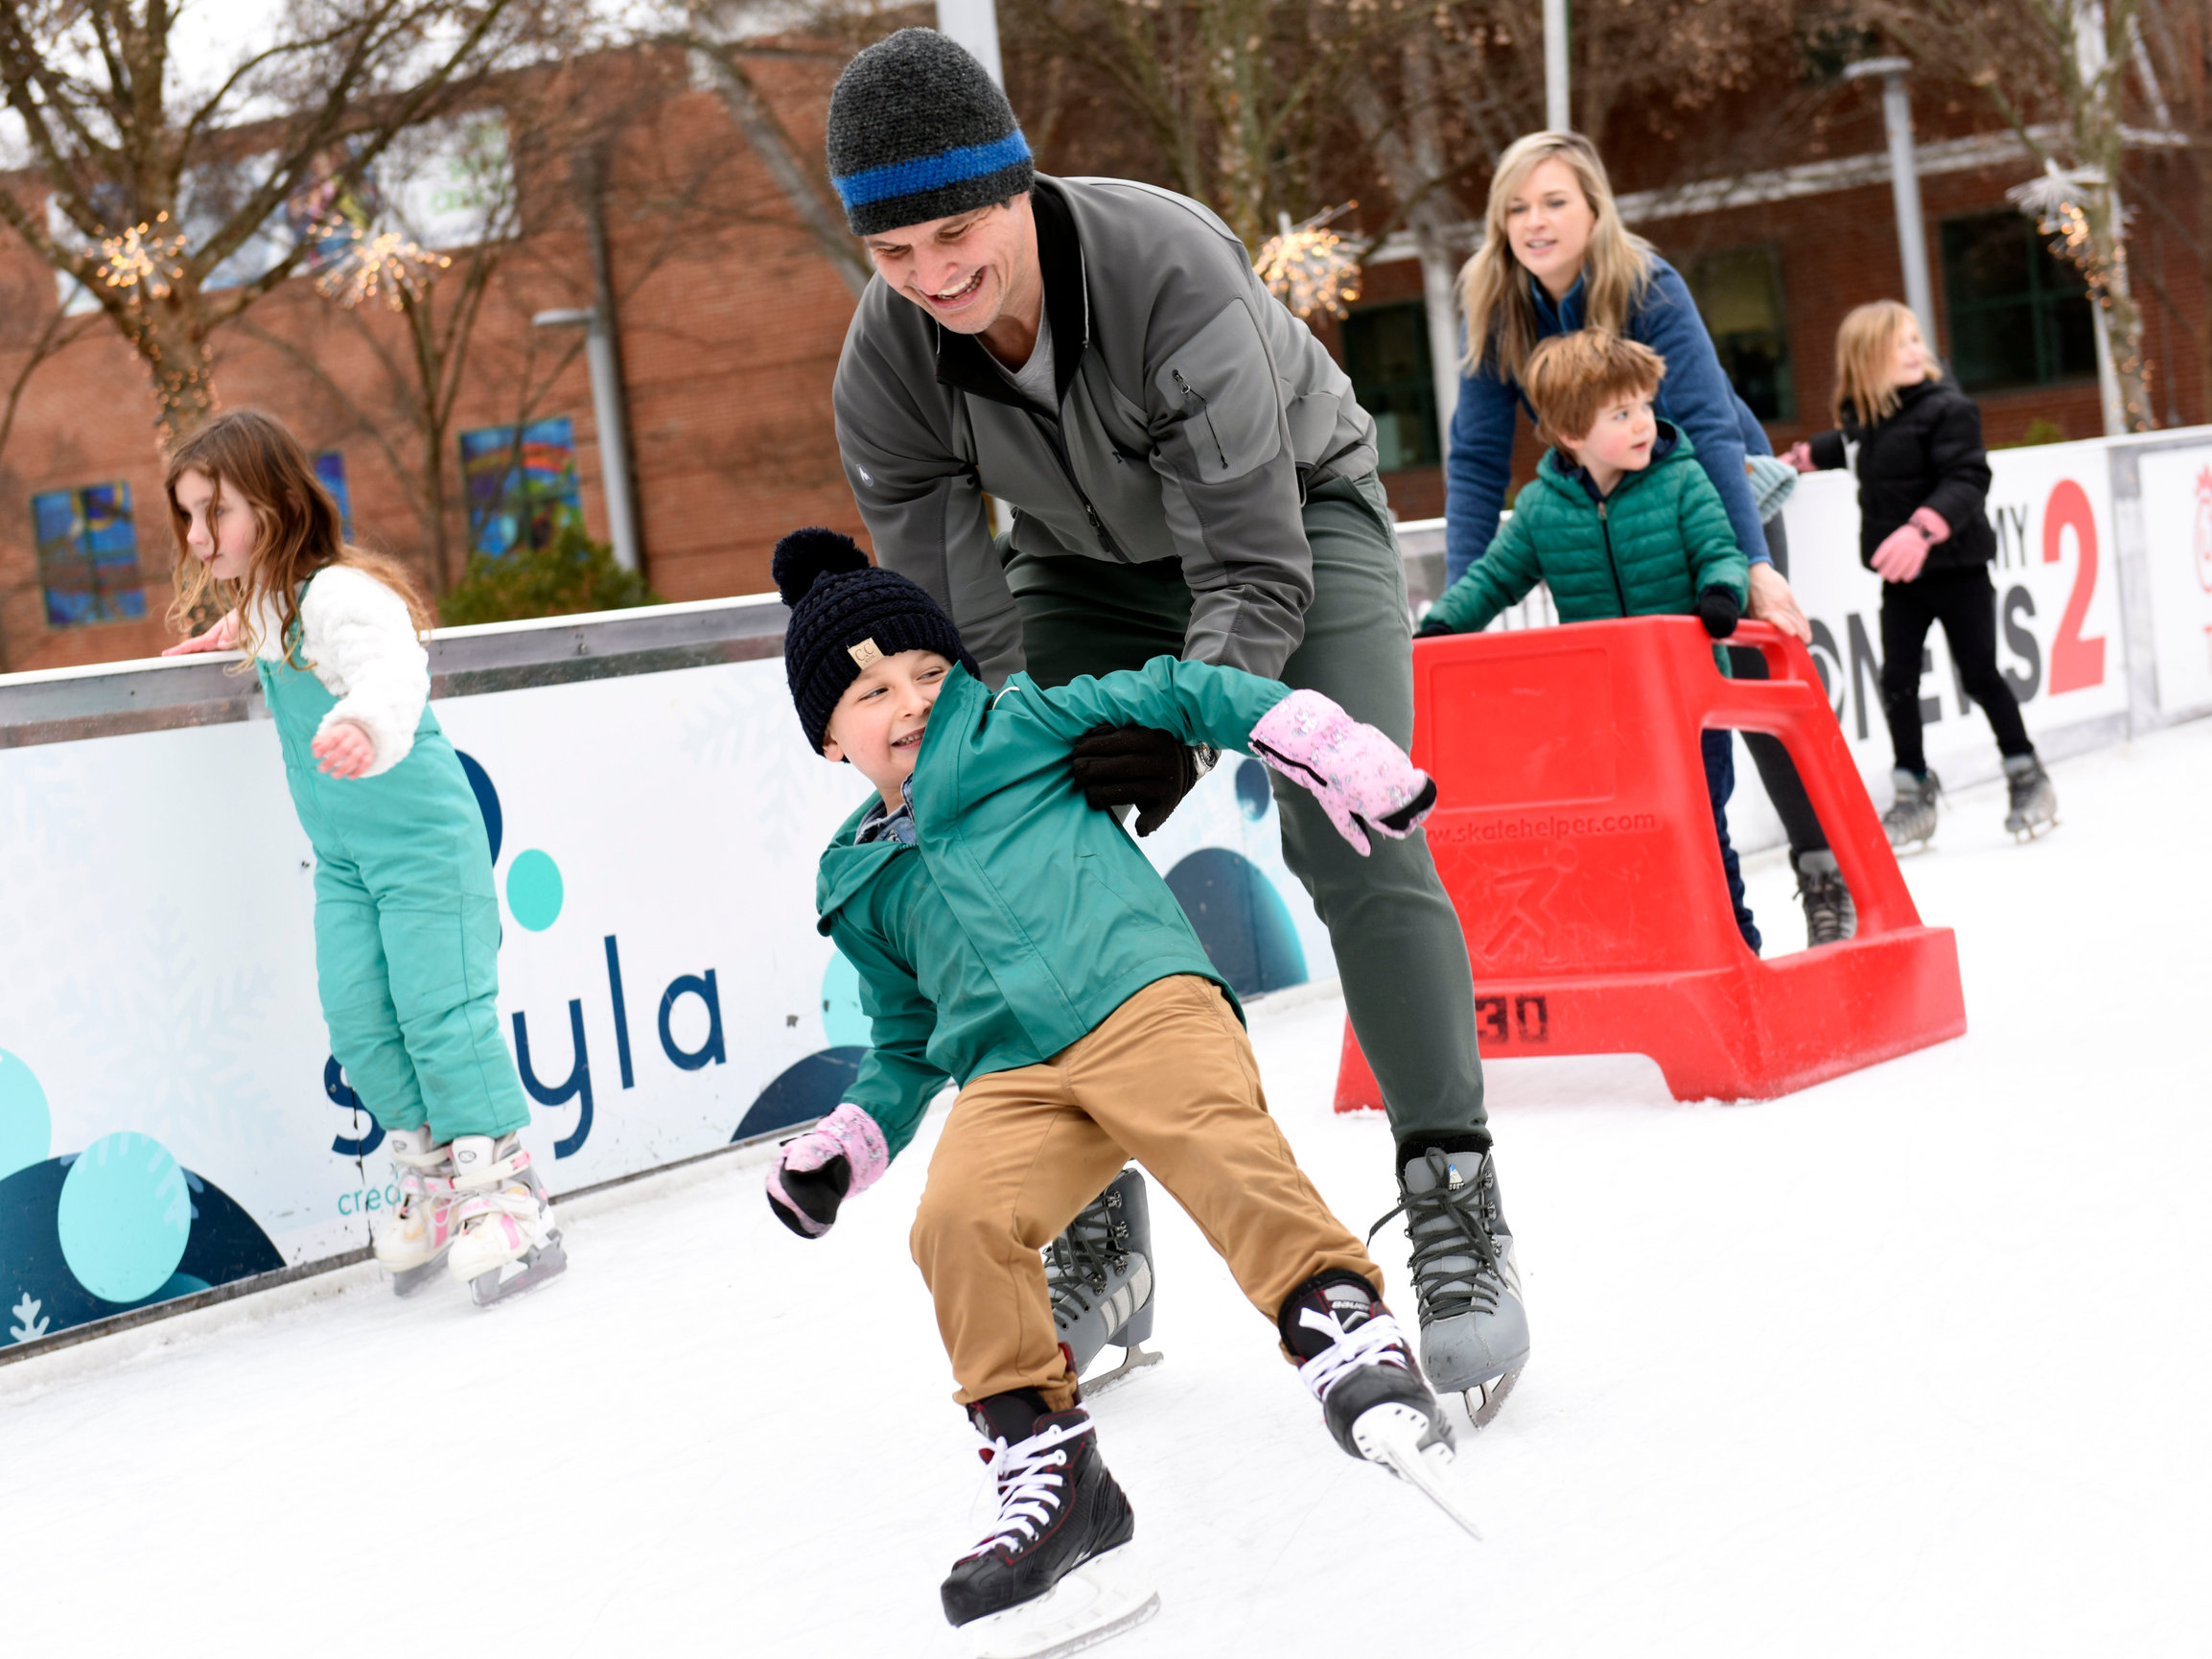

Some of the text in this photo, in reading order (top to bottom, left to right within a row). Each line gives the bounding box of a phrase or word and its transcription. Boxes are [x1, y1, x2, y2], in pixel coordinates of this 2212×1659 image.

[2042, 479, 2107, 697] 2
[323, 934, 727, 1160] syla
[1474, 994, 1548, 1045] 30
